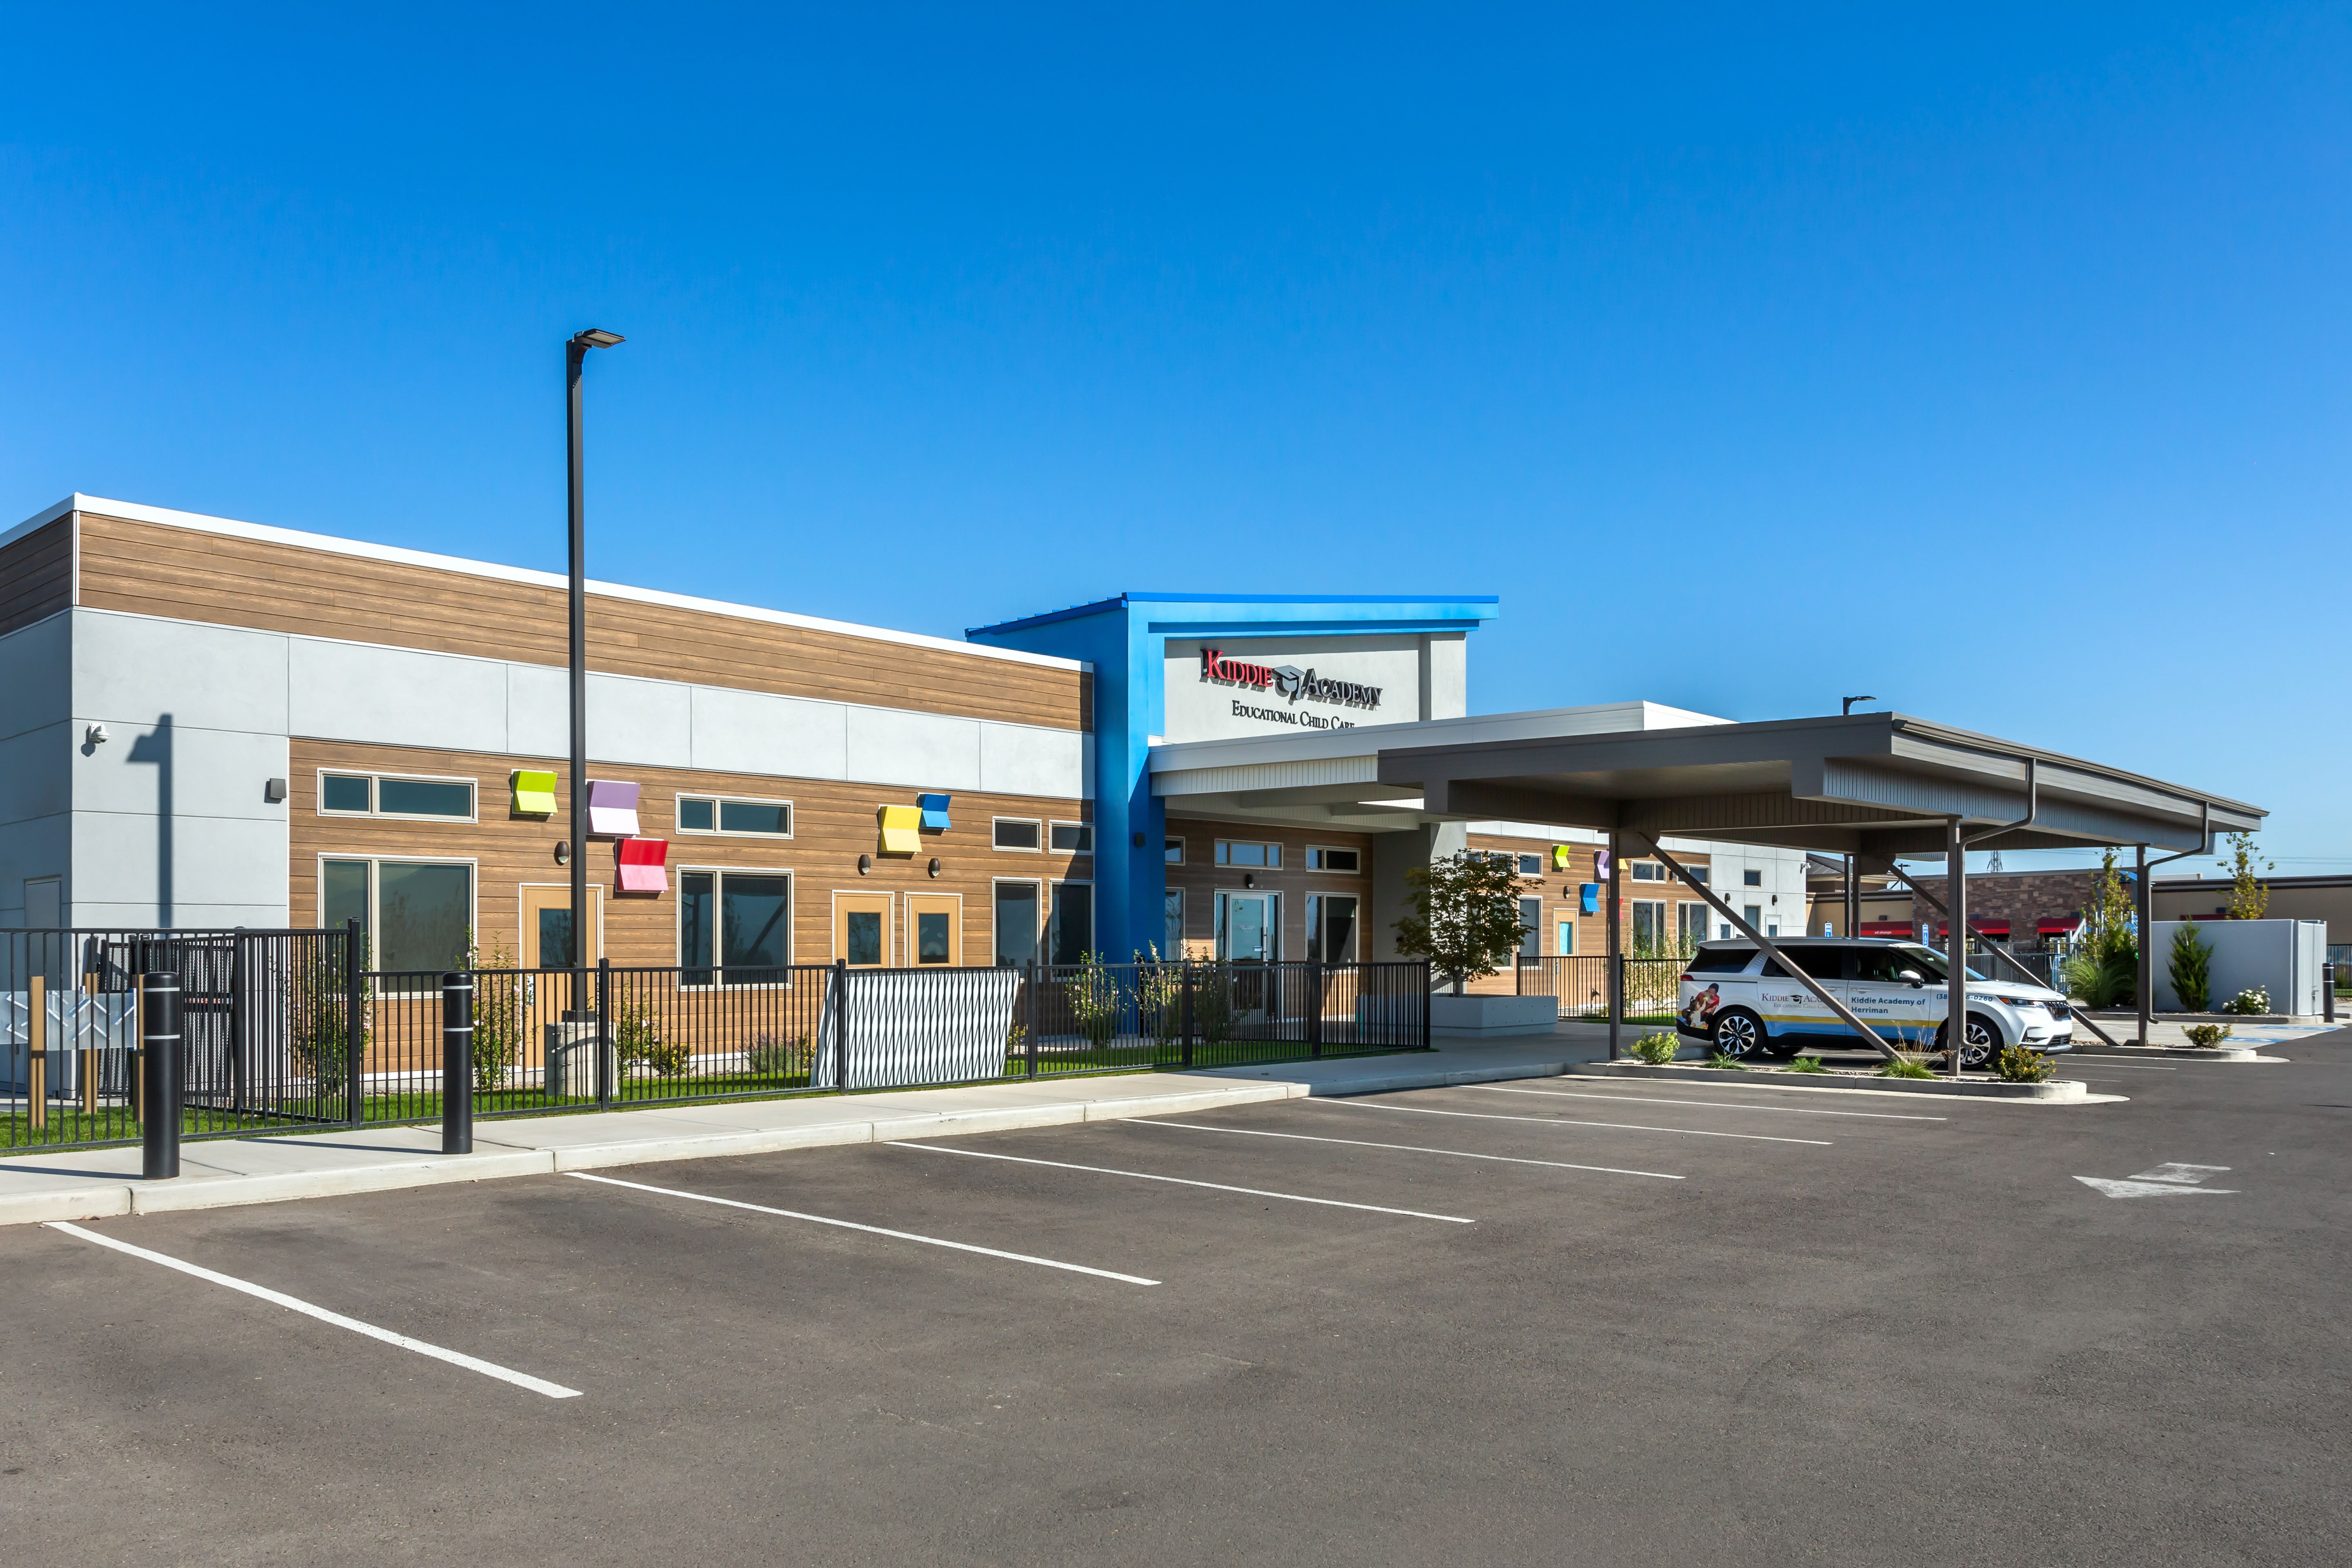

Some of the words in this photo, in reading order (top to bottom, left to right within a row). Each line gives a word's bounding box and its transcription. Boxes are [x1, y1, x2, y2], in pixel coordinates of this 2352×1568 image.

[1204, 648, 1273, 687] KIDDIE
[1303, 668, 1383, 706] ACADEMY
[1232, 700, 1298, 724] EDUCATIONAL
[1300, 711, 1328, 729] CHILD
[1762, 993, 1789, 1002] KIDDIE
[1878, 998, 1915, 1006] Academy
